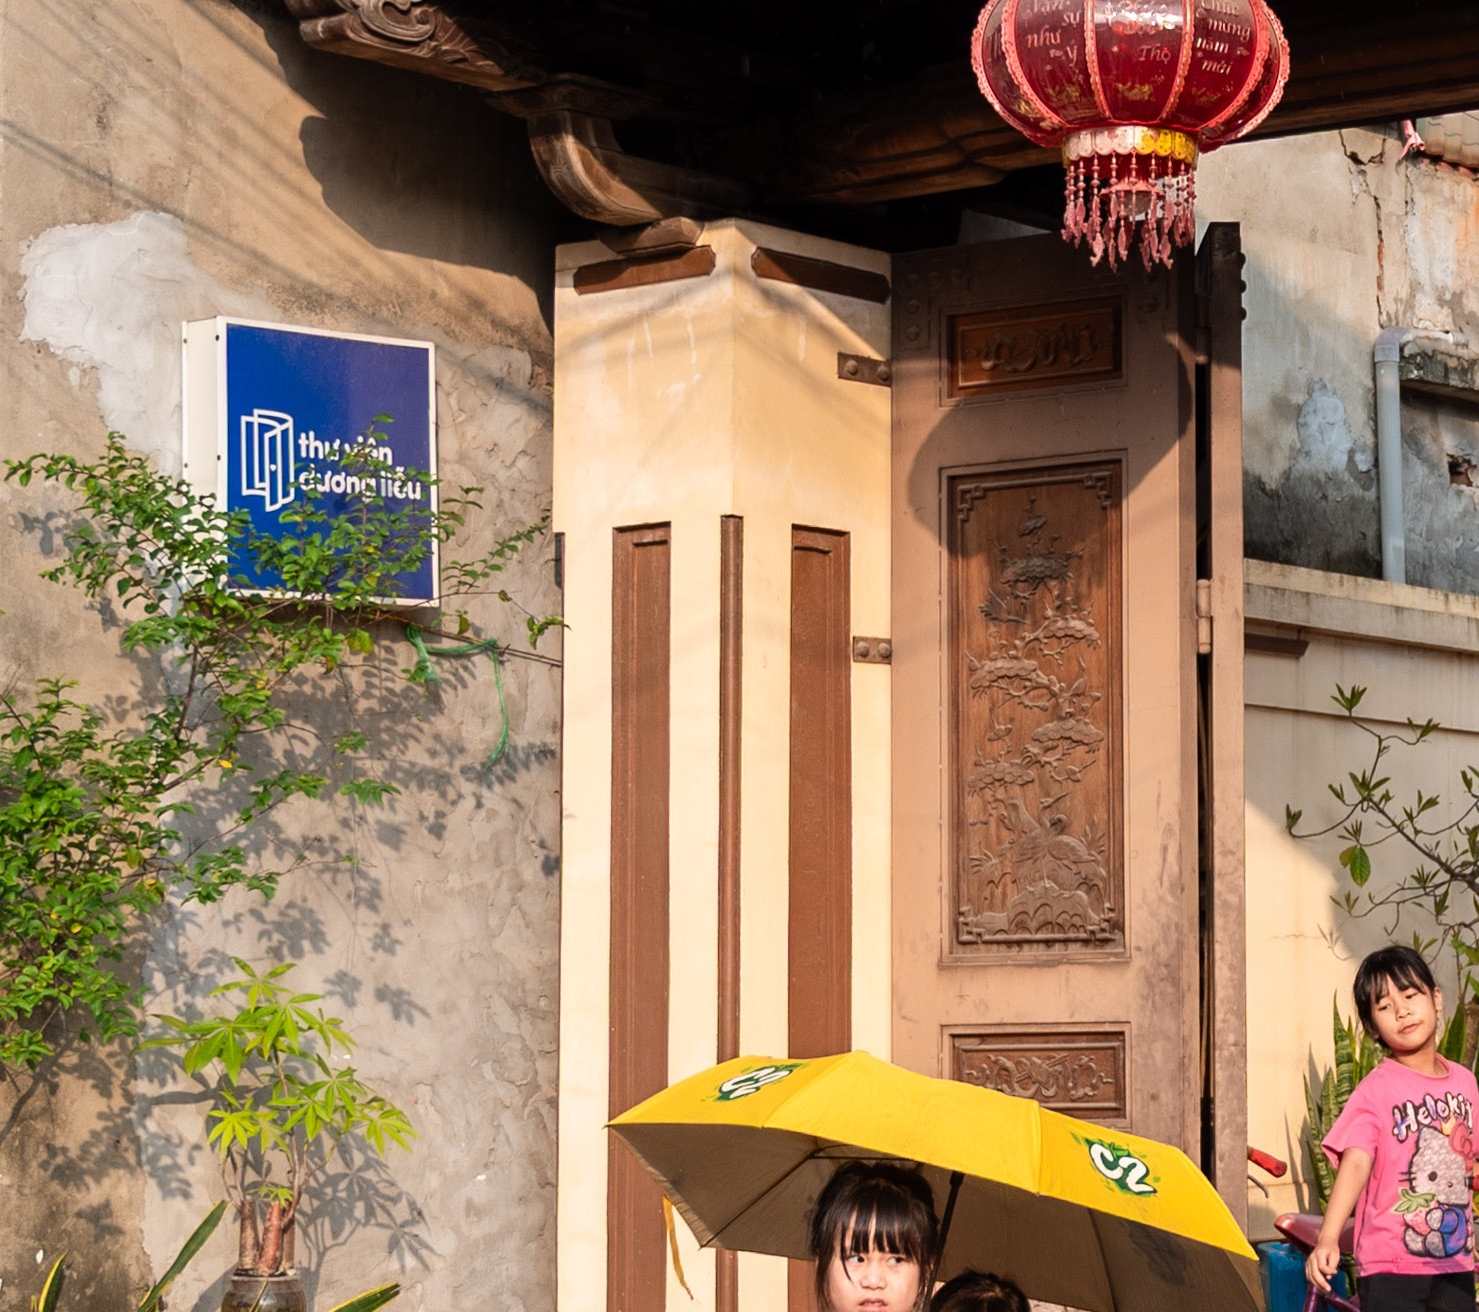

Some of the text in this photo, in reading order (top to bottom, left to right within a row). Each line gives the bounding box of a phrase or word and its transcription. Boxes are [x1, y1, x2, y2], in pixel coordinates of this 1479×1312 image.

[1026, 25, 1062, 48] như
[1138, 43, 1172, 65] Thọ
[719, 1066, 791, 1100] C2
[1089, 1142, 1157, 1194] C2
